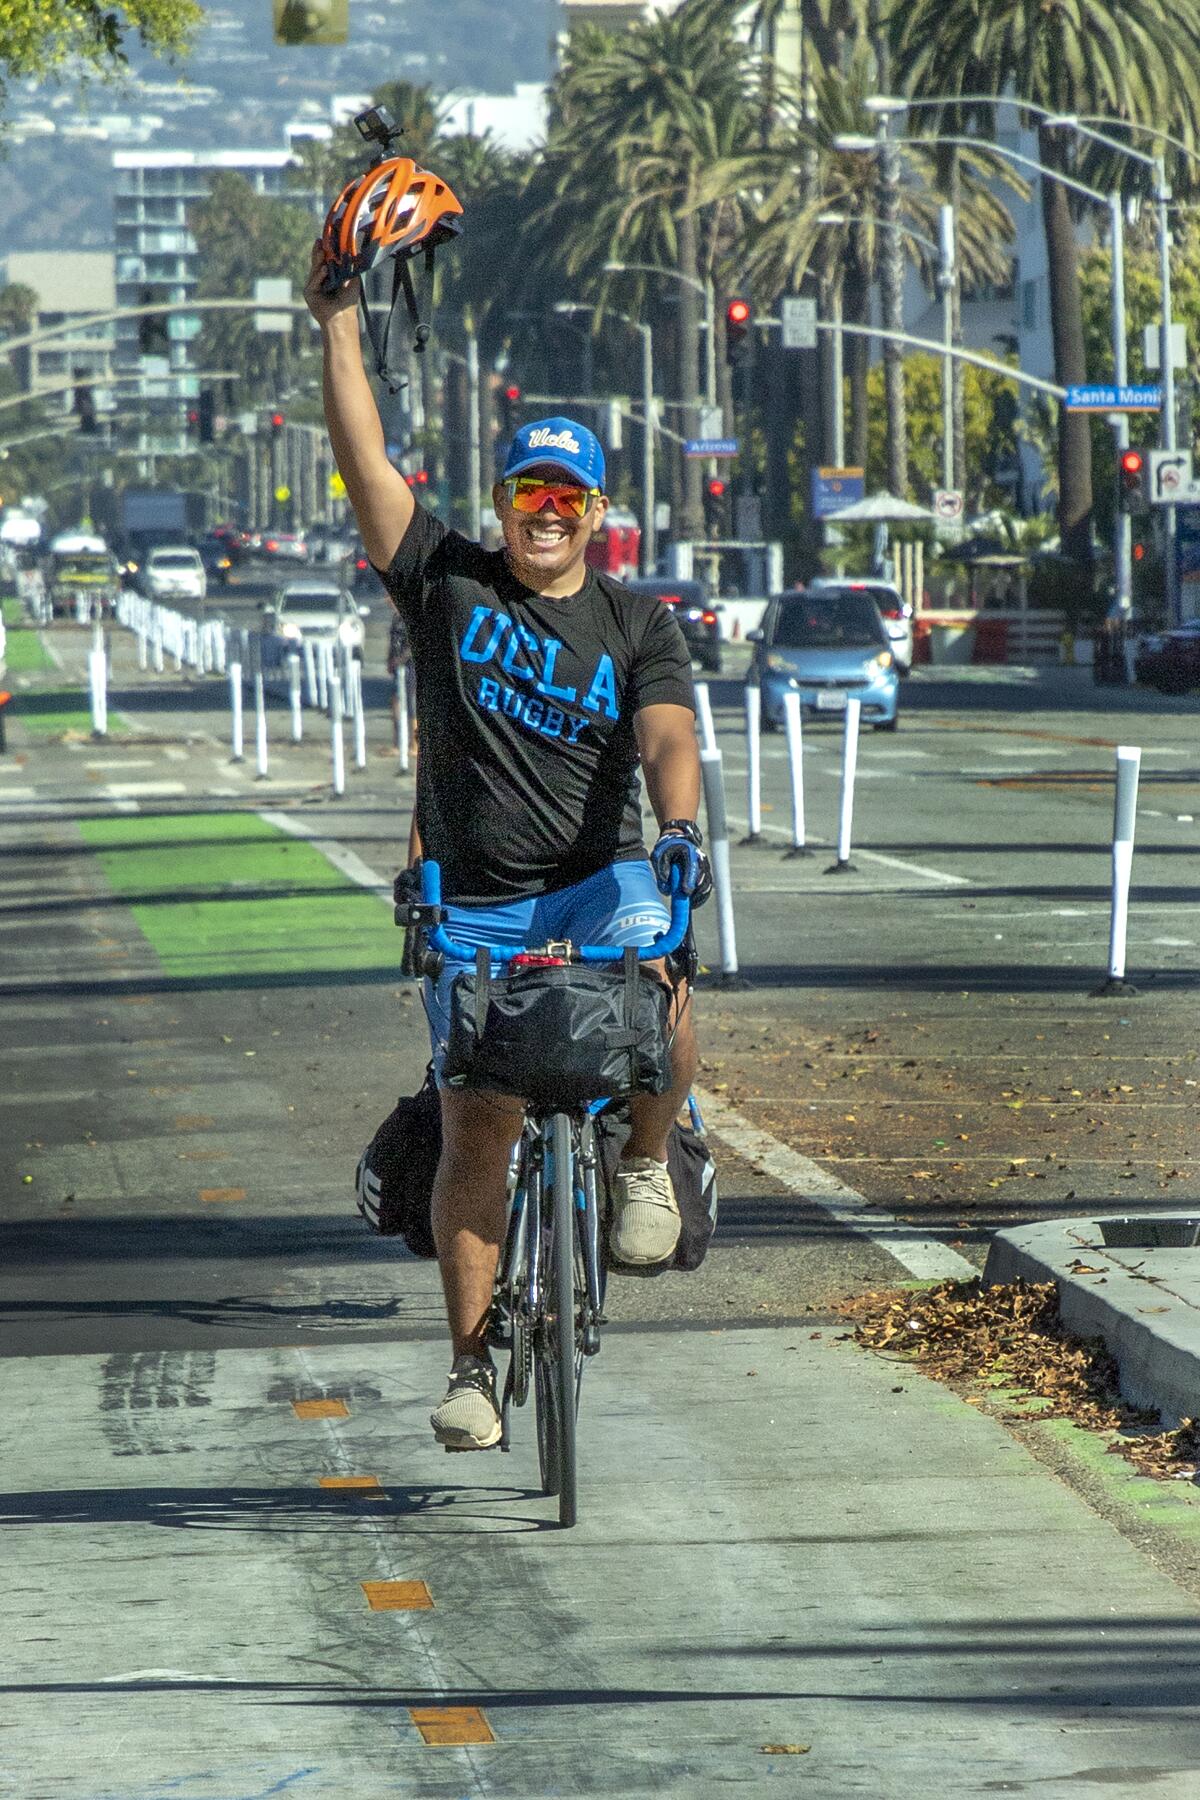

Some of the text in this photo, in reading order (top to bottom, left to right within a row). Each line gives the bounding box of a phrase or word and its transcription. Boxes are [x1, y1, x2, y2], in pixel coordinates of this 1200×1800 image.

[1071, 387, 1161, 404] Santa Moni
[460, 606, 619, 720] UCLA
[478, 677, 589, 743] RUGBY
